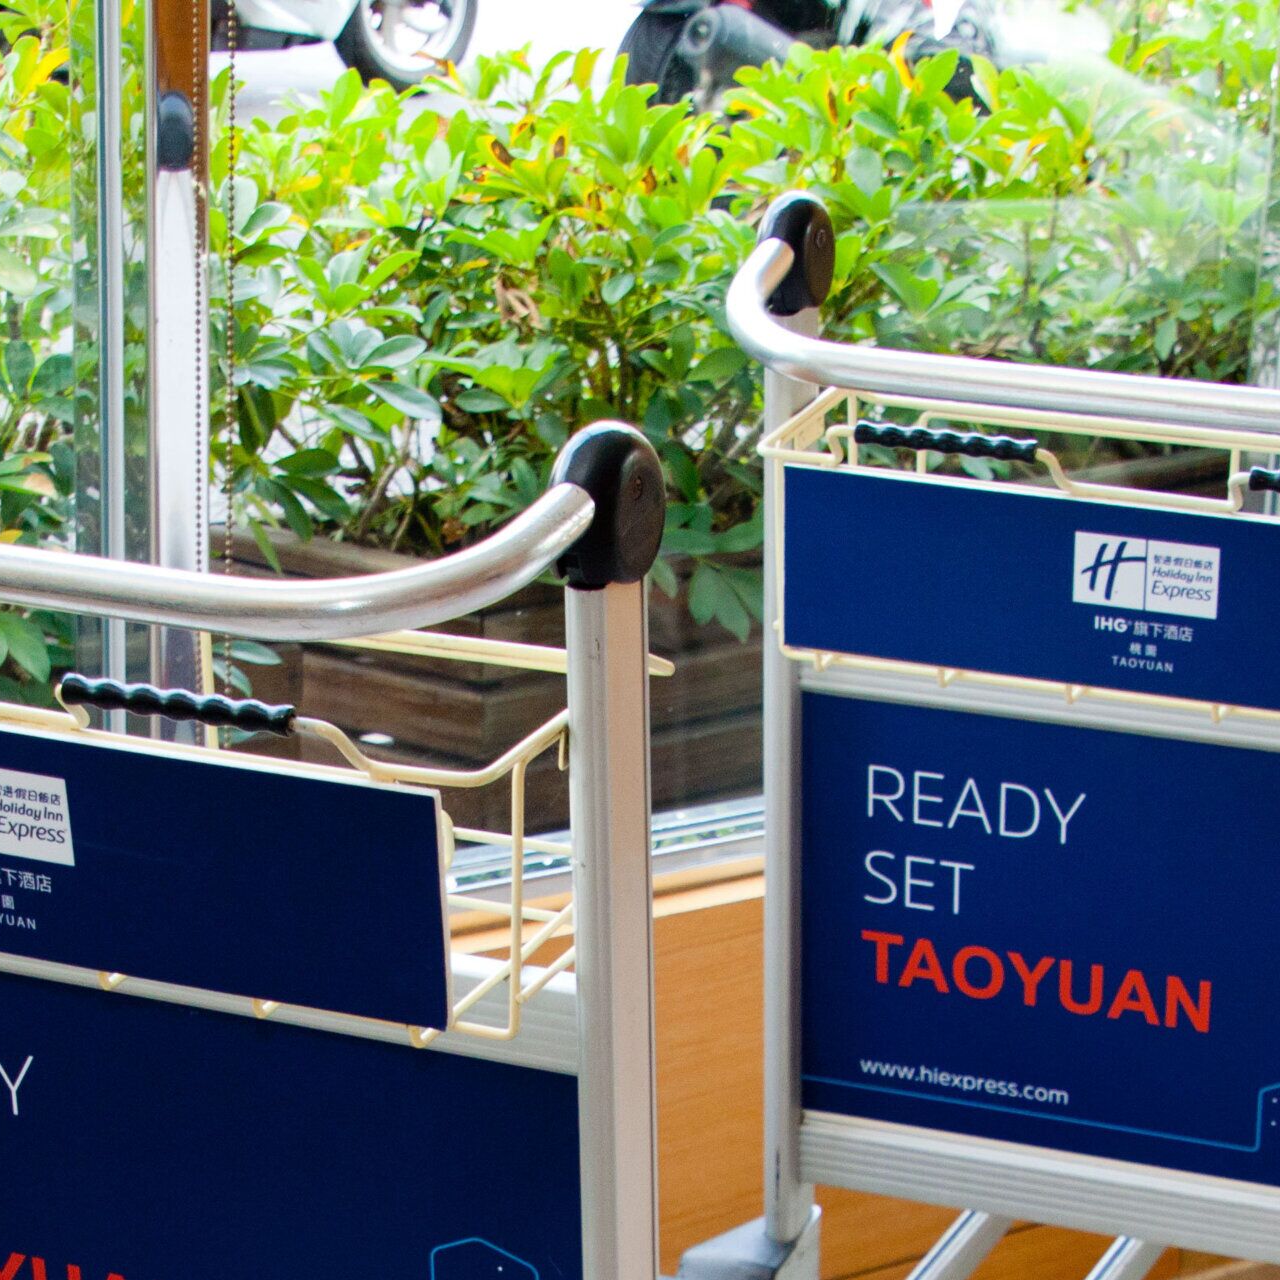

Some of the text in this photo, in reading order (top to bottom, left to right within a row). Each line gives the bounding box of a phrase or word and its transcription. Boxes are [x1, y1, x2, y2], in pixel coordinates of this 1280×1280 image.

[1151, 580, 1213, 602] Express
[1152, 566, 1213, 584] Holiday Inn
[1111, 655, 1174, 673] TAOYUAN
[43, 806, 64, 822] Inn
[867, 764, 1086, 845] READY
[864, 850, 976, 915] SET
[861, 929, 1212, 1034] TAOYUAN
[860, 1058, 1069, 1105] www.hiexpress.com
